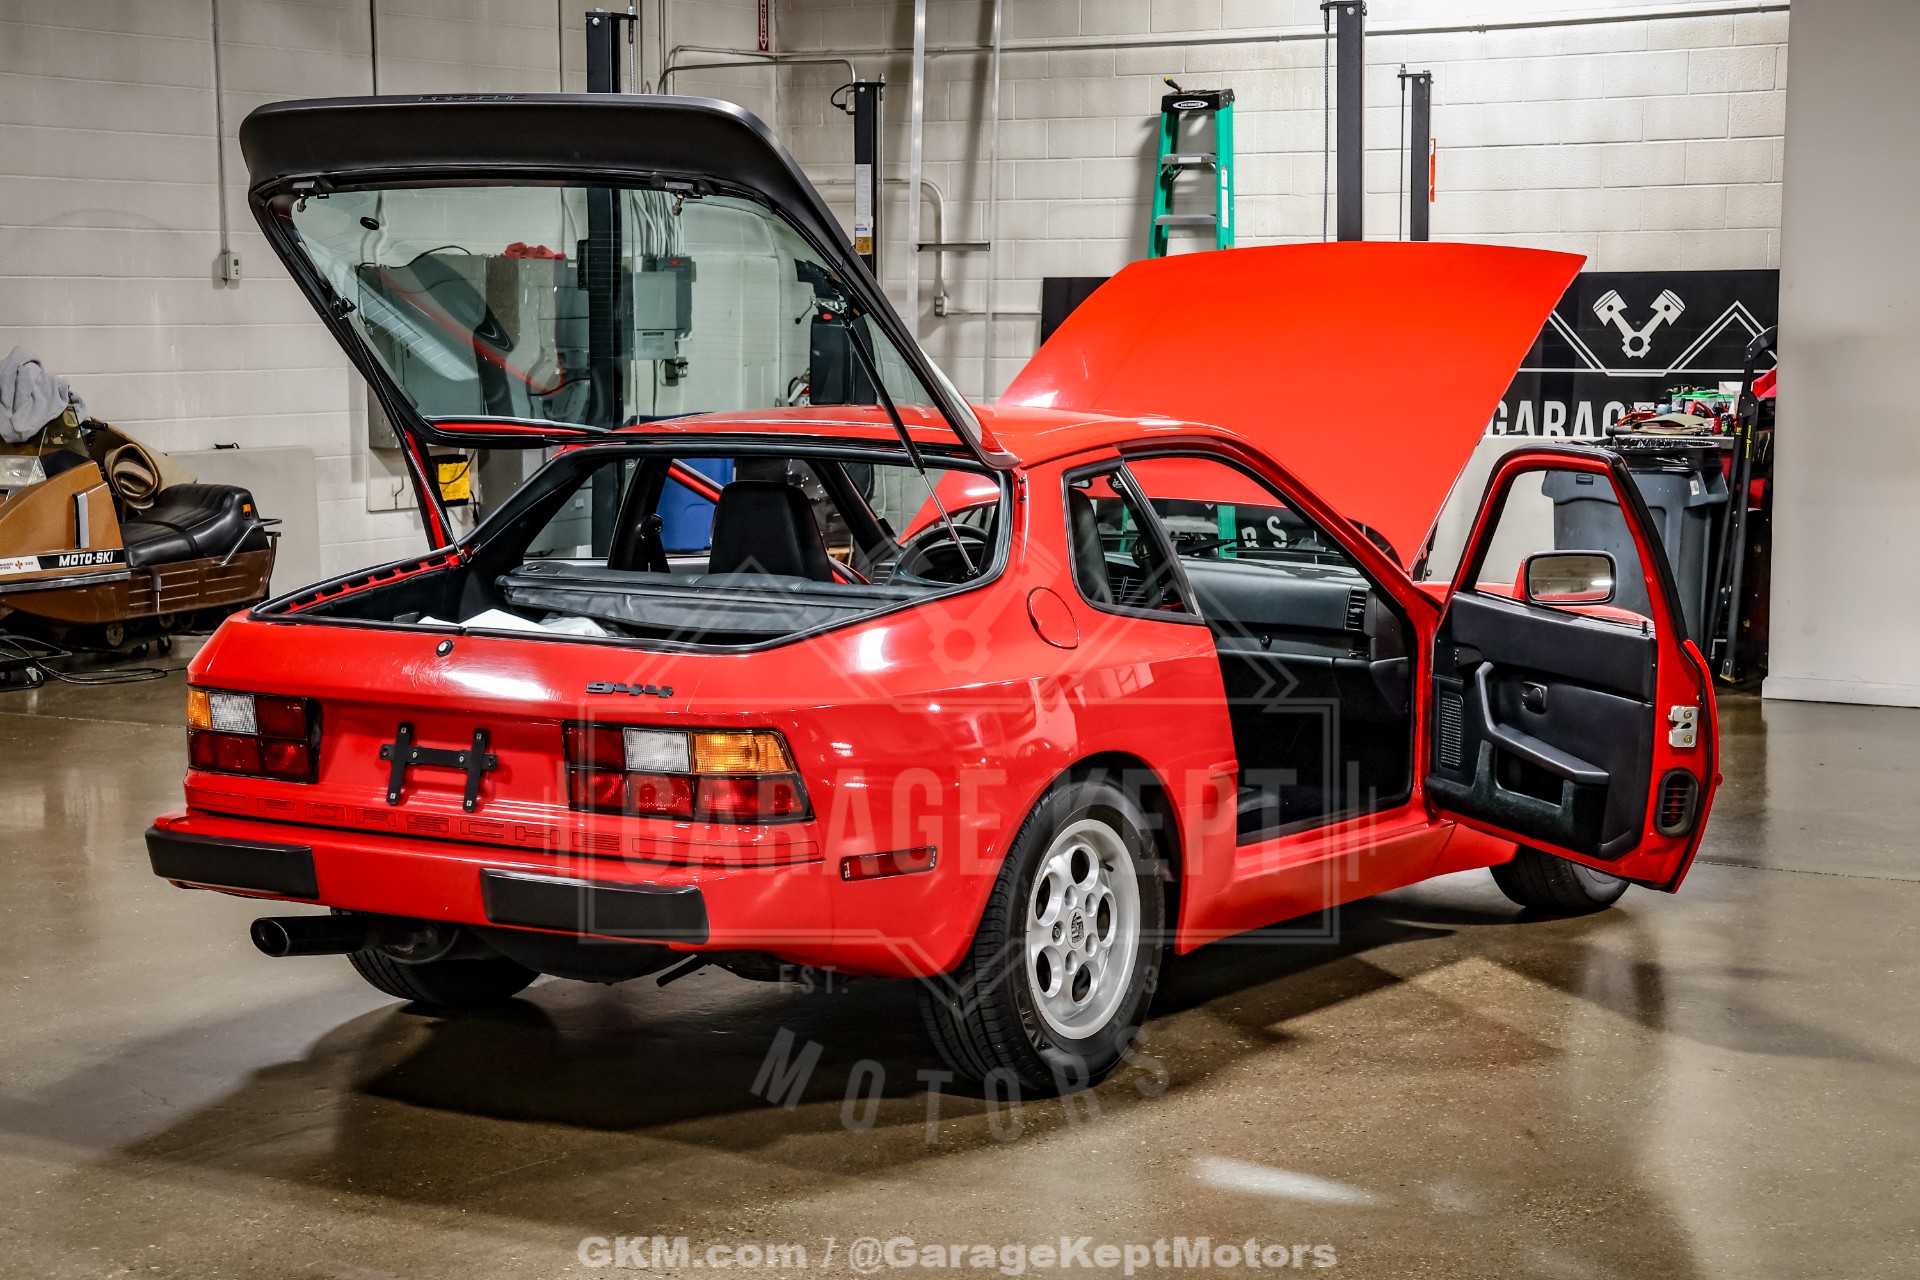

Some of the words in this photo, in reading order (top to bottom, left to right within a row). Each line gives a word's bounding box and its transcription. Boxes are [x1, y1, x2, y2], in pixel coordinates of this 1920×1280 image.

[1485, 400, 1655, 437] GARAG
[585, 681, 673, 699] 944
[257, 796, 620, 851] PORSCHE
